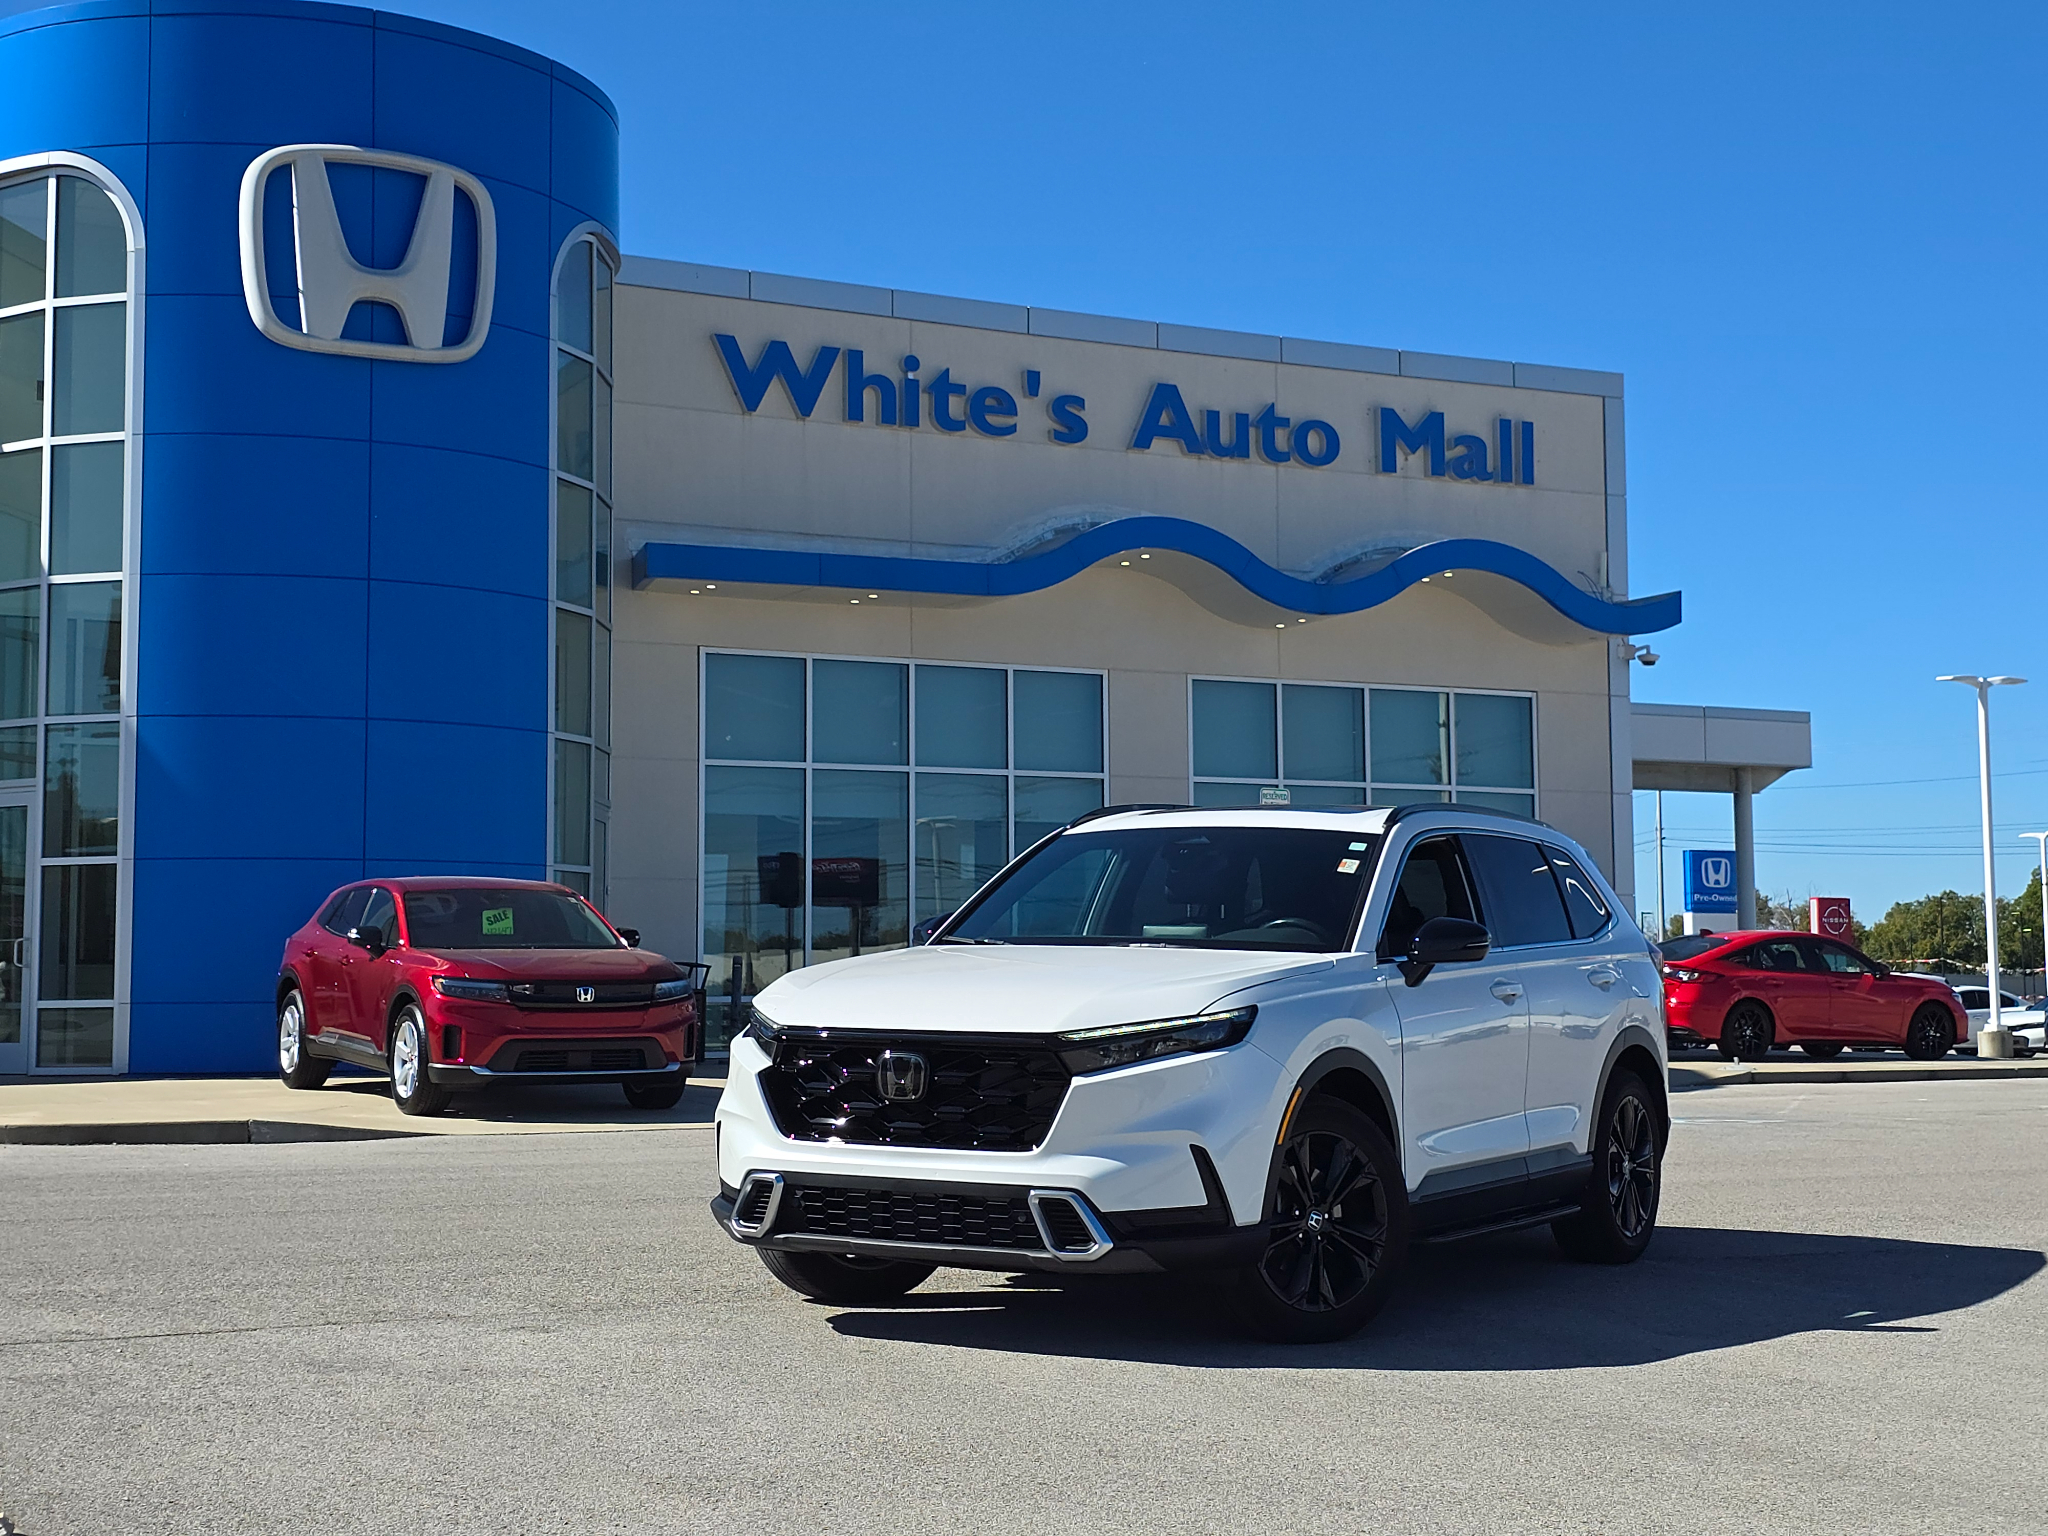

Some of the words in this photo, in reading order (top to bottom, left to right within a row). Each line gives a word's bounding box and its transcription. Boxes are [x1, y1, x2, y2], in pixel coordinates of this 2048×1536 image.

[711, 333, 1089, 445] White's
[1128, 382, 1341, 468] Auto
[1375, 406, 1534, 485] Mall
[1694, 893, 1737, 902] Pre-Owned
[486, 910, 510, 926] SALE
